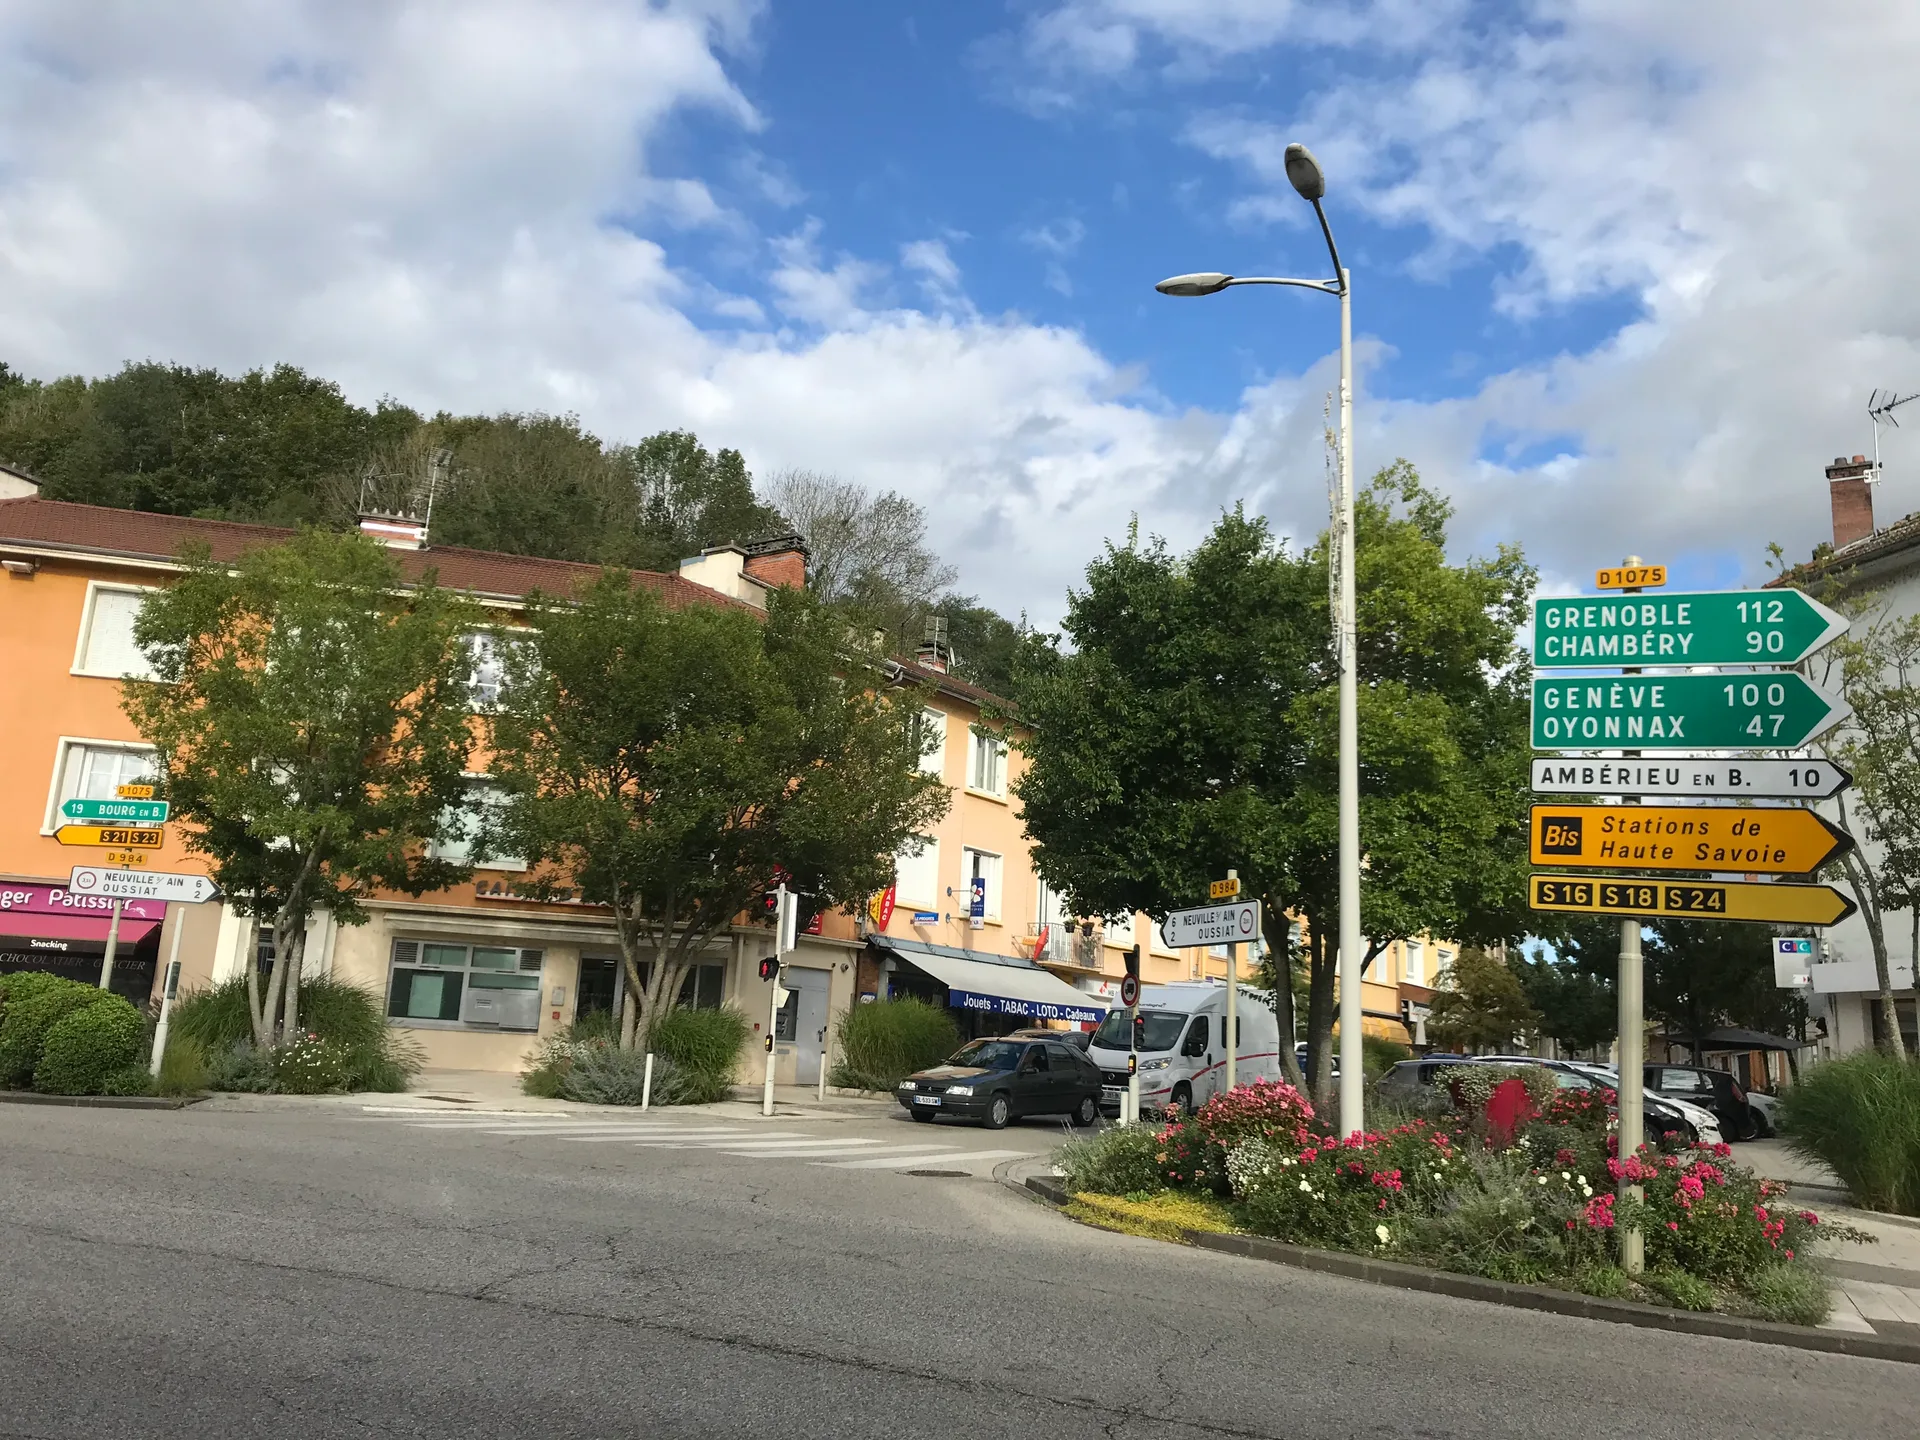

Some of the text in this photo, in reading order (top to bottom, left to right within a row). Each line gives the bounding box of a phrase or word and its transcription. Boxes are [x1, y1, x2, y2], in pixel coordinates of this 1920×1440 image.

[1600, 568, 1662, 585] D 1075
[1545, 600, 1784, 629] GRENOBLE 112
[1544, 630, 1784, 658] CHAMBÉRY 90
[1543, 683, 1785, 710] GENÈVE 100
[1543, 714, 1785, 738] OYONNAX 47
[1541, 764, 1820, 788] AMBÉRIEU EN B. 10
[118, 786, 151, 796] D 1075
[71, 803, 84, 814] 19
[98, 804, 136, 816] BOURG
[139, 809, 149, 817] EN
[1601, 815, 1761, 837] Stations de
[102, 831, 157, 844] S 21 S 23
[1544, 825, 1579, 847] Bis
[108, 852, 143, 863] D 984
[1600, 840, 1787, 864] Haute Savoie
[104, 873, 154, 885] NEUVILLE
[167, 877, 184, 887] AIN
[195, 880, 202, 888] 6
[1212, 881, 1236, 895] D 984
[0, 890, 34, 909] ger
[103, 884, 201, 899] OUSSIAT 2
[1542, 884, 1721, 910] S 16 S 18 S 24
[1171, 917, 1176, 928] 6
[1183, 912, 1215, 926] NEUVILLE
[1223, 909, 1236, 922] AIN
[1170, 925, 1235, 942] 2 OUSSIAT
[30, 939, 68, 951] Snacking
[1781, 942, 1809, 952] CIC
[93, 959, 146, 970] GACIER
[963, 993, 991, 1010] Jouets
[1000, 1000, 1029, 1016] TABAC
[1037, 1004, 1058, 1019] LOTO
[1065, 1008, 1097, 1022] Cadeaux
